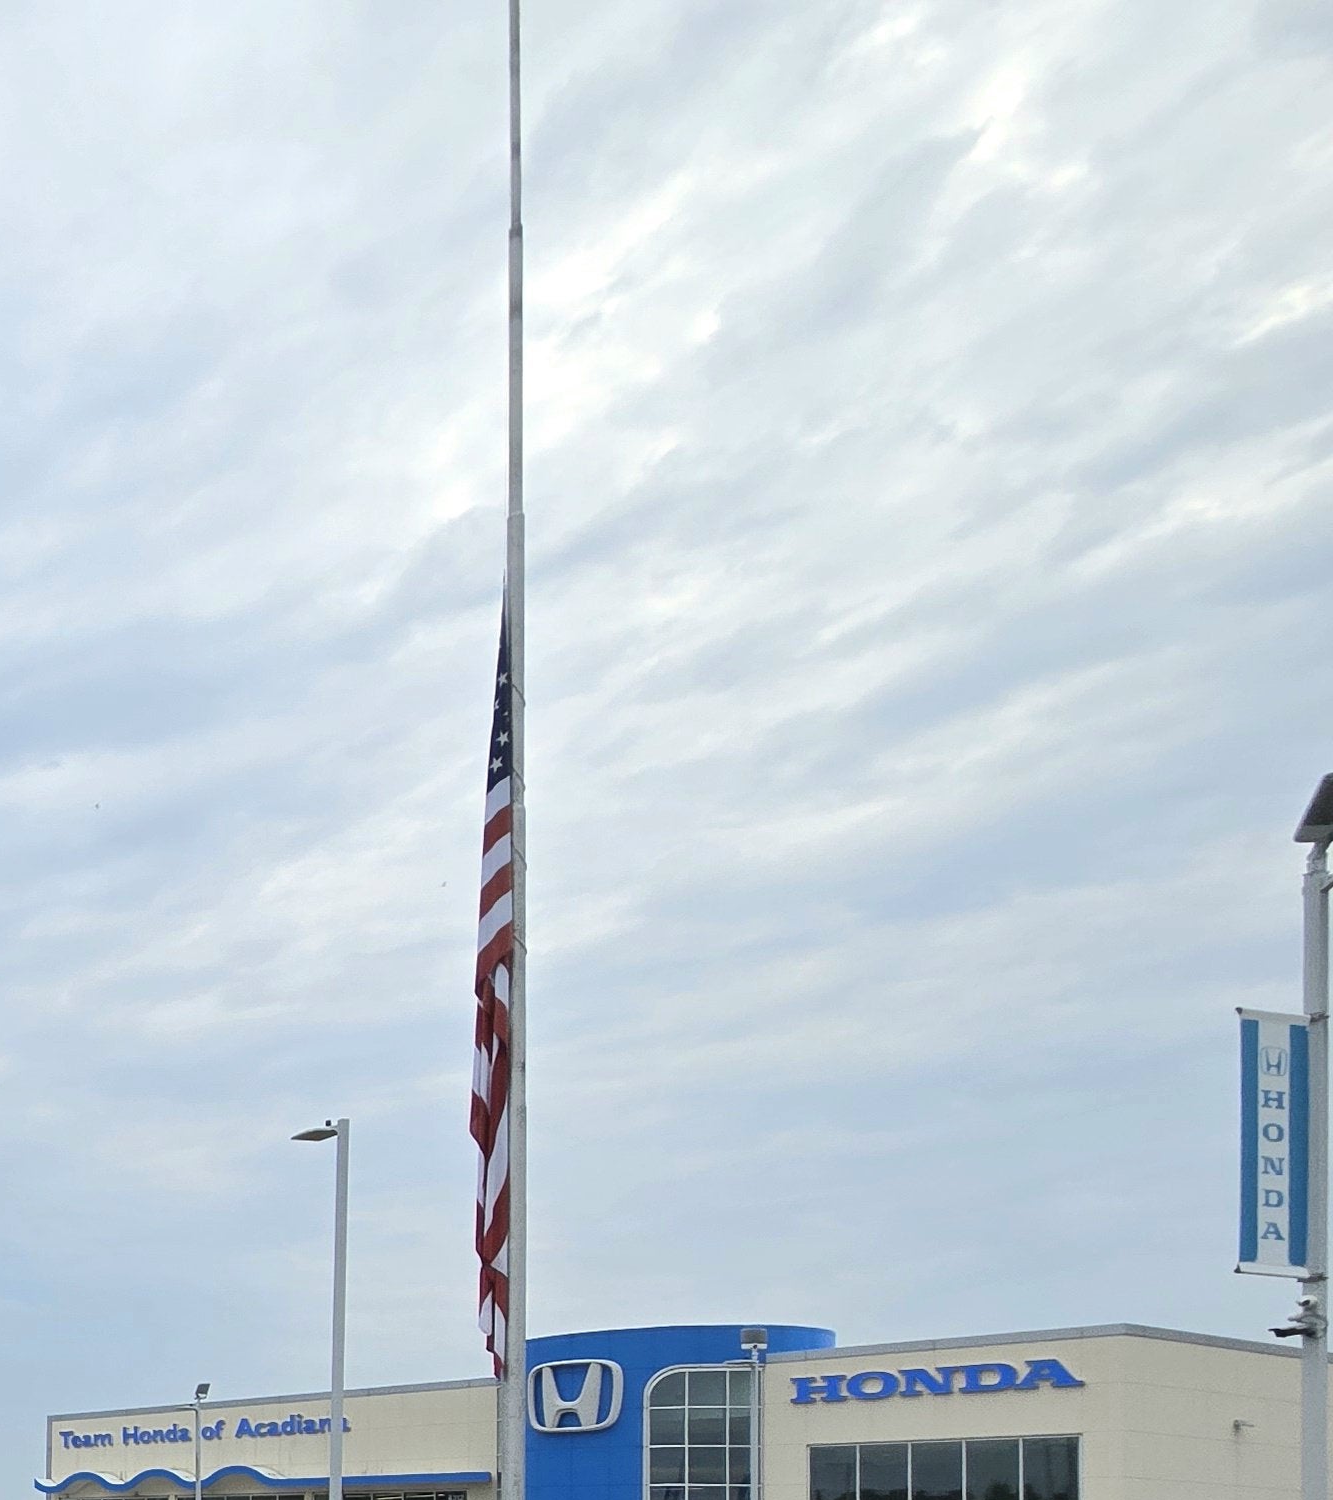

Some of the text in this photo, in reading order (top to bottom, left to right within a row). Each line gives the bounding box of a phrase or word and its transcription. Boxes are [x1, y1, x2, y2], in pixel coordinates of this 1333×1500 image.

[1260, 1089, 1286, 1241] HONDA
[789, 1357, 1086, 1405] HONDA
[58, 1430, 114, 1449] Team
[122, 1423, 193, 1447] Honda
[201, 1419, 227, 1441] of
